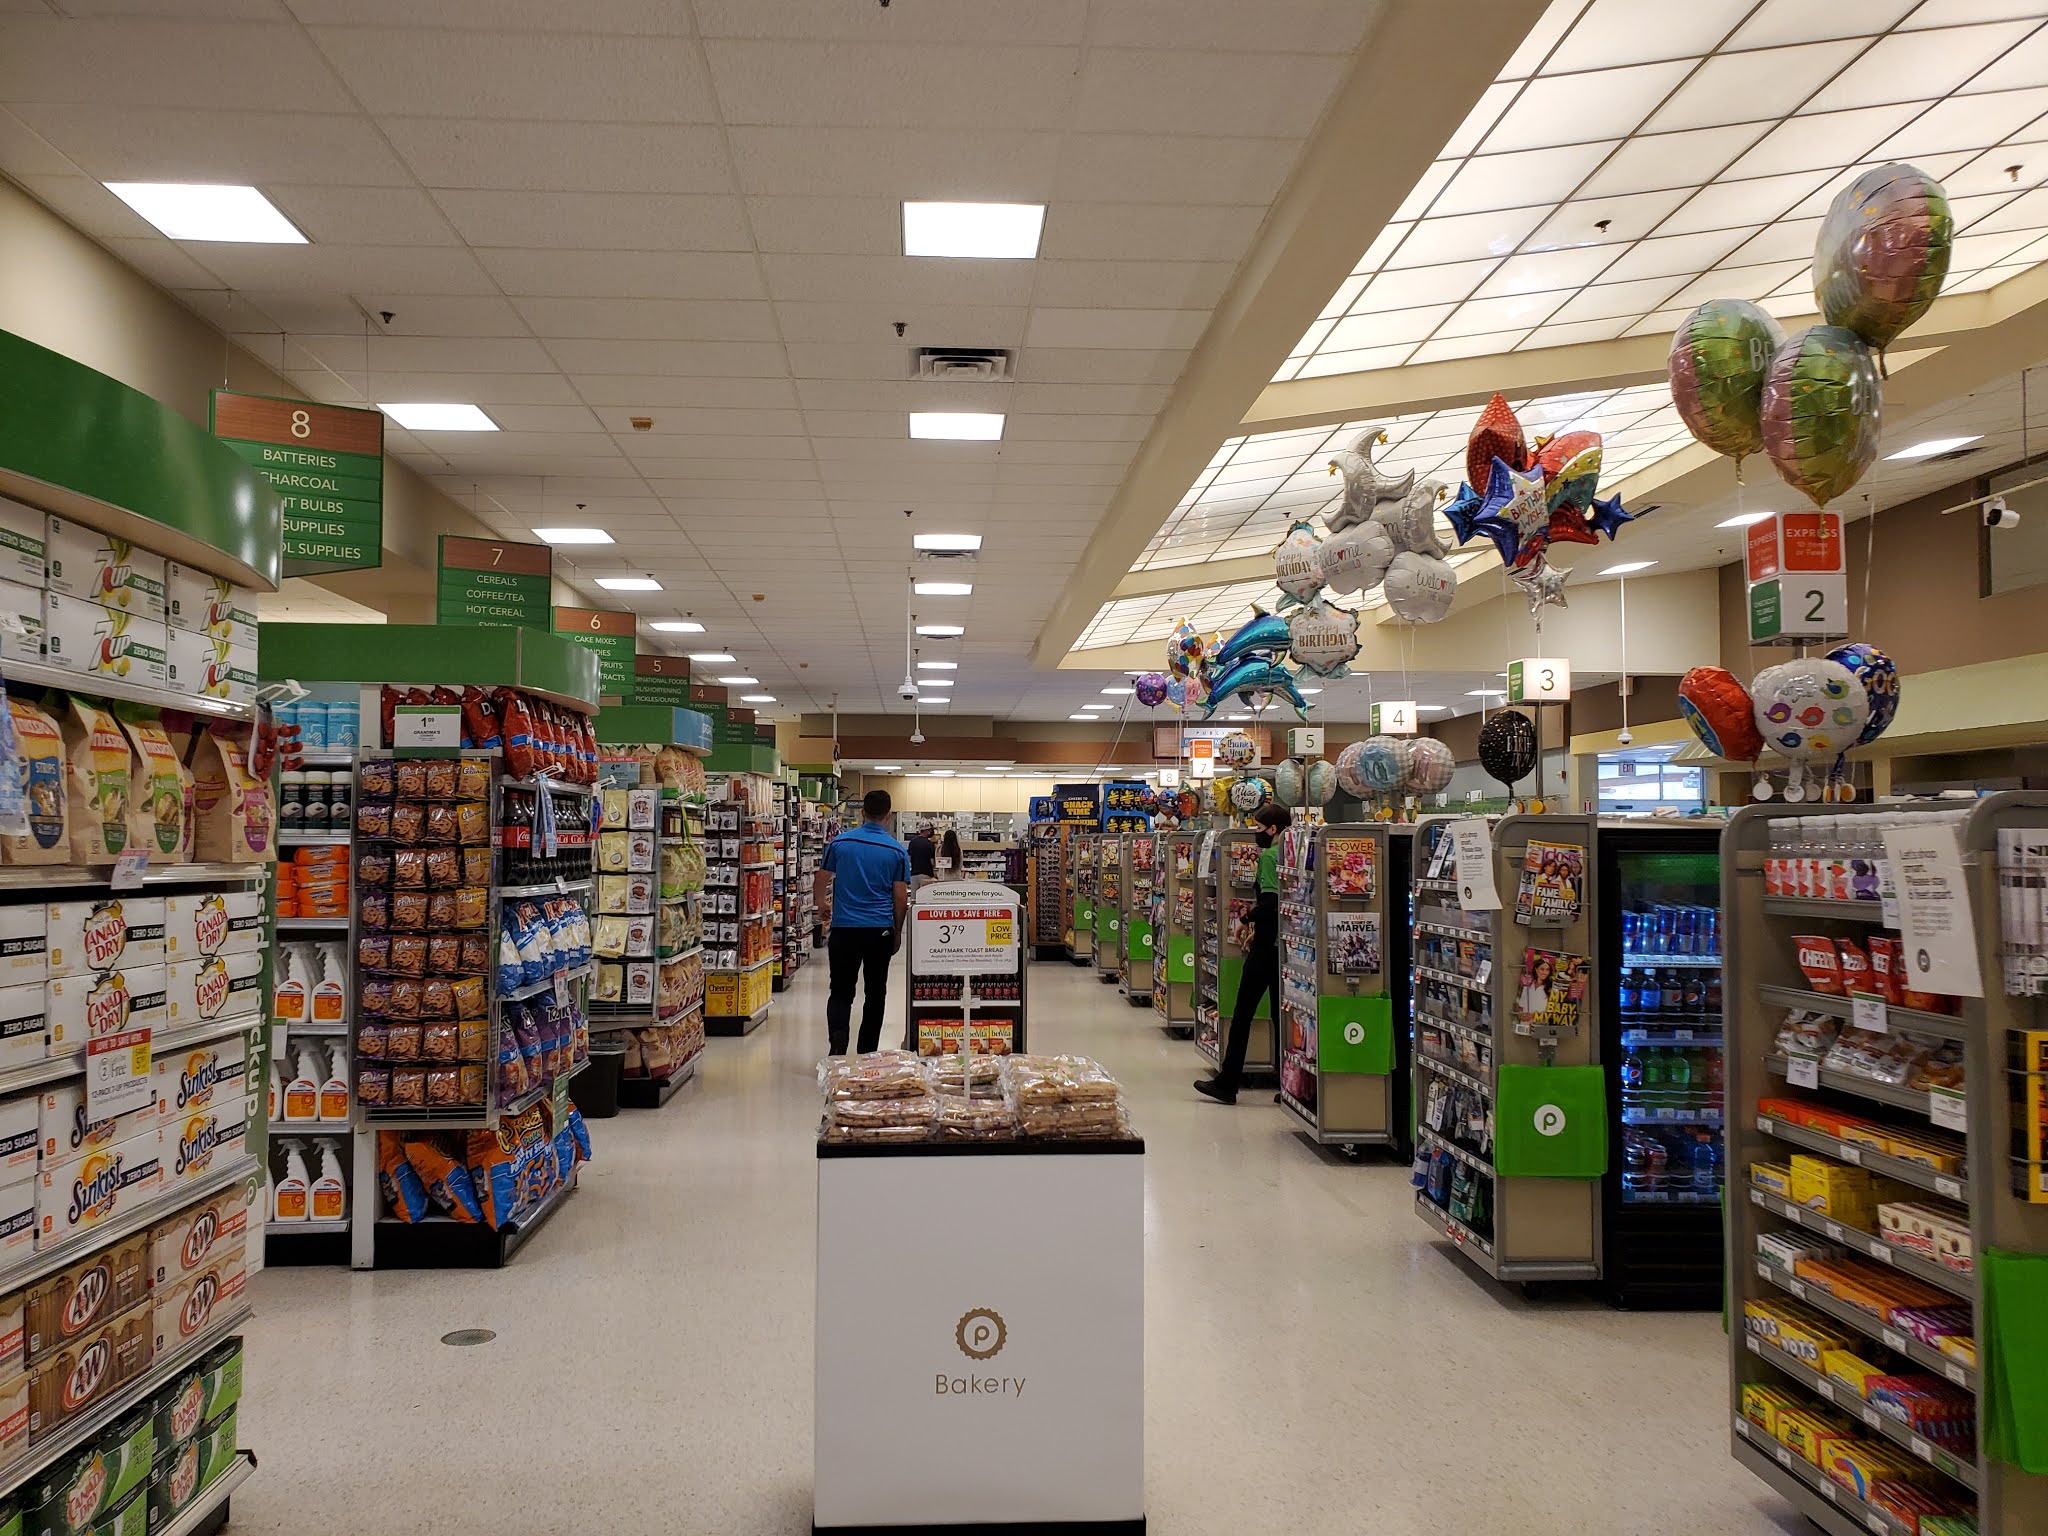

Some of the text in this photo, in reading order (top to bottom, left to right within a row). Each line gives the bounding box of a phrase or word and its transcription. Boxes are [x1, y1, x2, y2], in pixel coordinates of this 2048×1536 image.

[291, 410, 311, 438] 8
[263, 449, 337, 468] BATTERIES
[300, 499, 344, 513] BULBS
[282, 519, 345, 536] SUPPLIES
[298, 543, 361, 559] SUPPLIES
[491, 548, 504, 566] 7
[476, 574, 518, 587] CEREALS
[466, 589, 526, 602] COFFEE/TEA
[466, 605, 526, 618] HOT CEREAL
[1805, 590, 1825, 621] 2
[590, 614, 601, 630] 6
[574, 635, 617, 645] CAKE MIXES
[1299, 634, 1348, 648] BIRTHDAY
[653, 660, 662, 673] 5
[1540, 669, 1554, 691] 3
[635, 695, 680, 703] PICKLES/OLIVES
[698, 688, 705, 699] 4
[729, 711, 736, 720] 3
[1393, 709, 1405, 727] 4
[754, 727, 759, 735] 2
[1305, 734, 1314, 748] 5
[1200, 763, 1207, 774] 7
[1166, 773, 1173, 782] 8
[1063, 801, 1094, 809] SNACK
[1066, 808, 1091, 816] TIME
[1328, 842, 1374, 852] FLOWER
[933, 889, 966, 898] Something
[1536, 886, 1559, 898] FAME
[1541, 897, 1570, 909] FAMILY
[930, 910, 948, 918] LOVE
[984, 909, 1003, 917] HERE.
[195, 908, 228, 949] CANADA DRY
[232, 918, 244, 929] ZERO
[1336, 924, 1377, 932] MARVEL
[84, 915, 127, 962] CANADA DRY
[132, 927, 147, 939] ZERO
[990, 932, 1012, 940] PRICE
[3, 942, 21, 954] ZERO
[196, 969, 229, 1012] CANADA DRY
[233, 980, 243, 990] ZERO
[708, 983, 735, 993] Cheerios
[1549, 990, 1568, 1003] MY
[87, 986, 130, 1028] CANADA
[135, 998, 150, 1009] ZERO
[99, 1009, 122, 1034] DRY
[1533, 1011, 1577, 1026] MY WAY
[4, 1022, 21, 1035] ZERO
[934, 1373, 1027, 1398] Bakery
